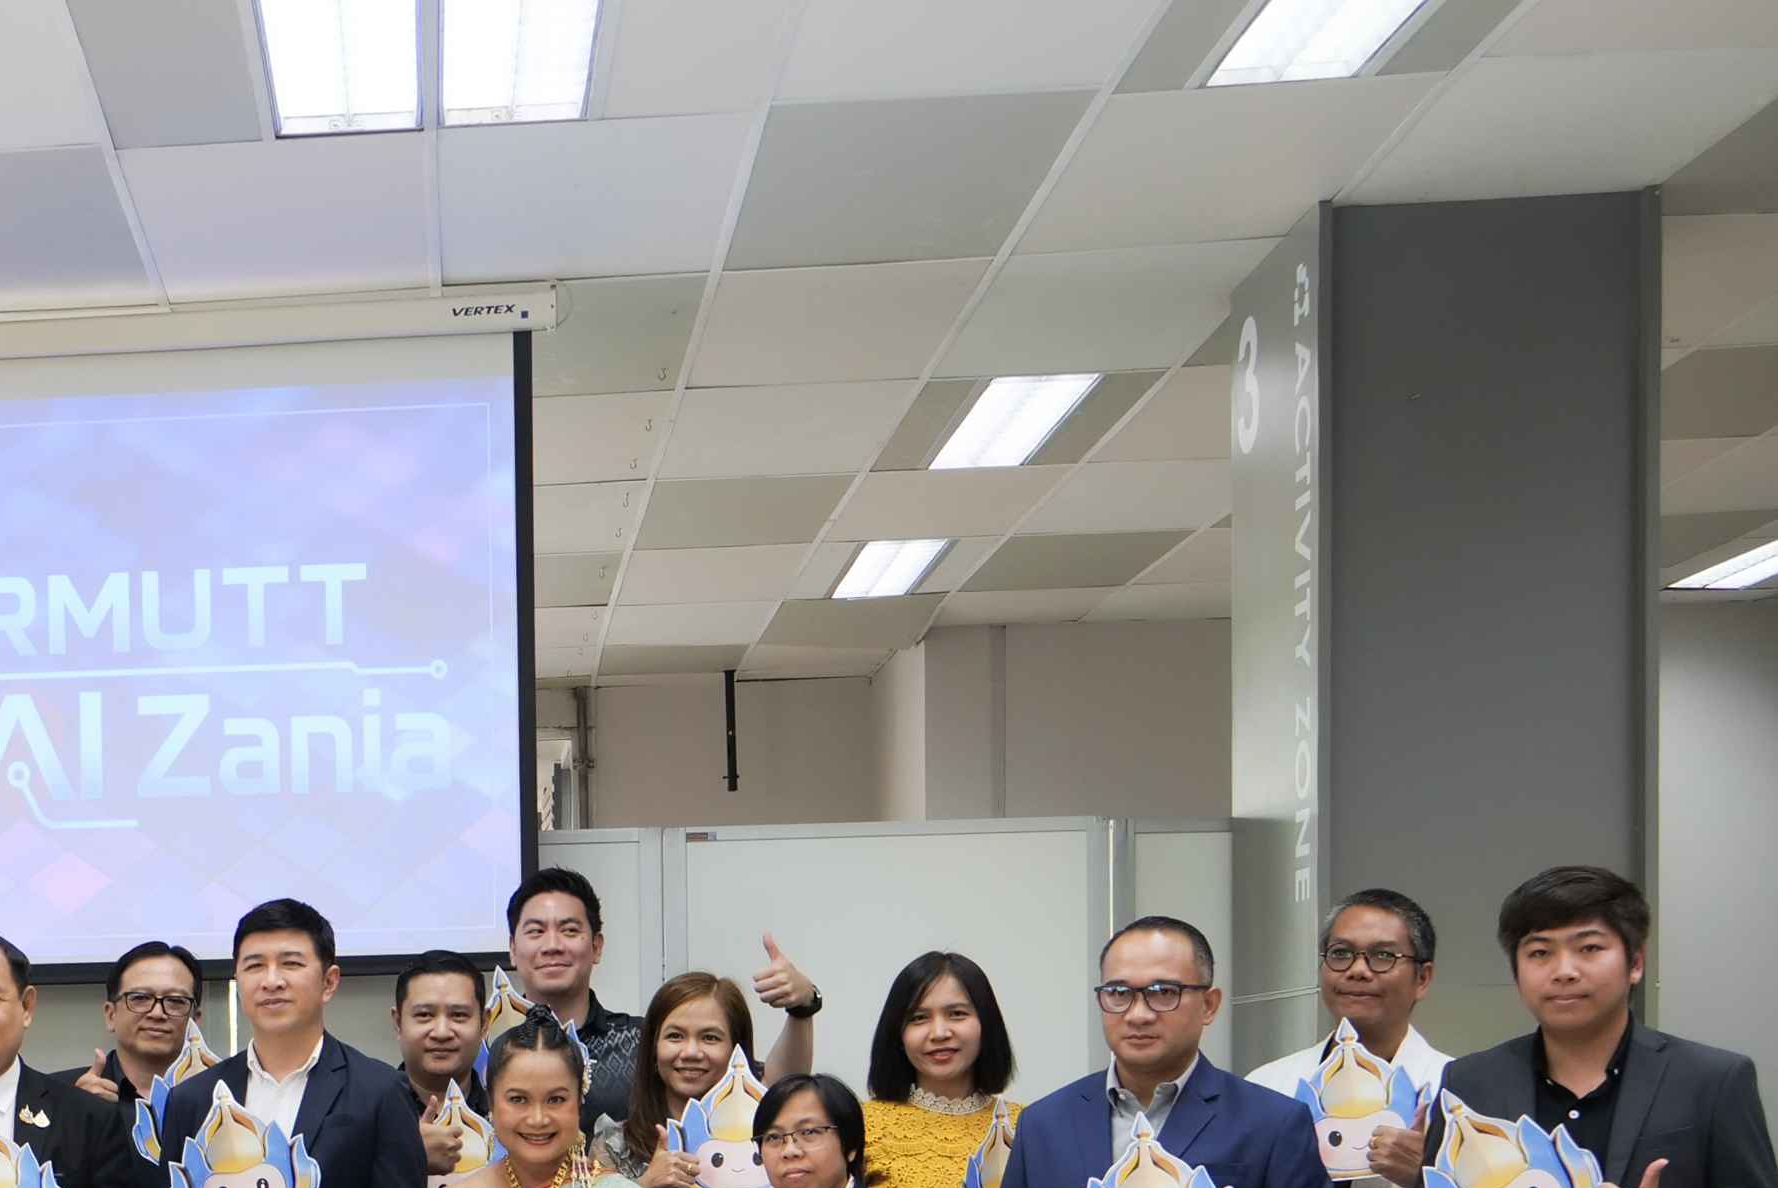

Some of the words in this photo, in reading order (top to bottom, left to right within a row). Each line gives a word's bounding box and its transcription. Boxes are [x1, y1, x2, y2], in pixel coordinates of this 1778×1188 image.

[451, 303, 516, 317] VERTEX
[1237, 315, 1261, 455] 3
[1294, 341, 1311, 668] ACTIVITY
[135, 687, 453, 801] Zania
[1294, 695, 1311, 904] ZONE
